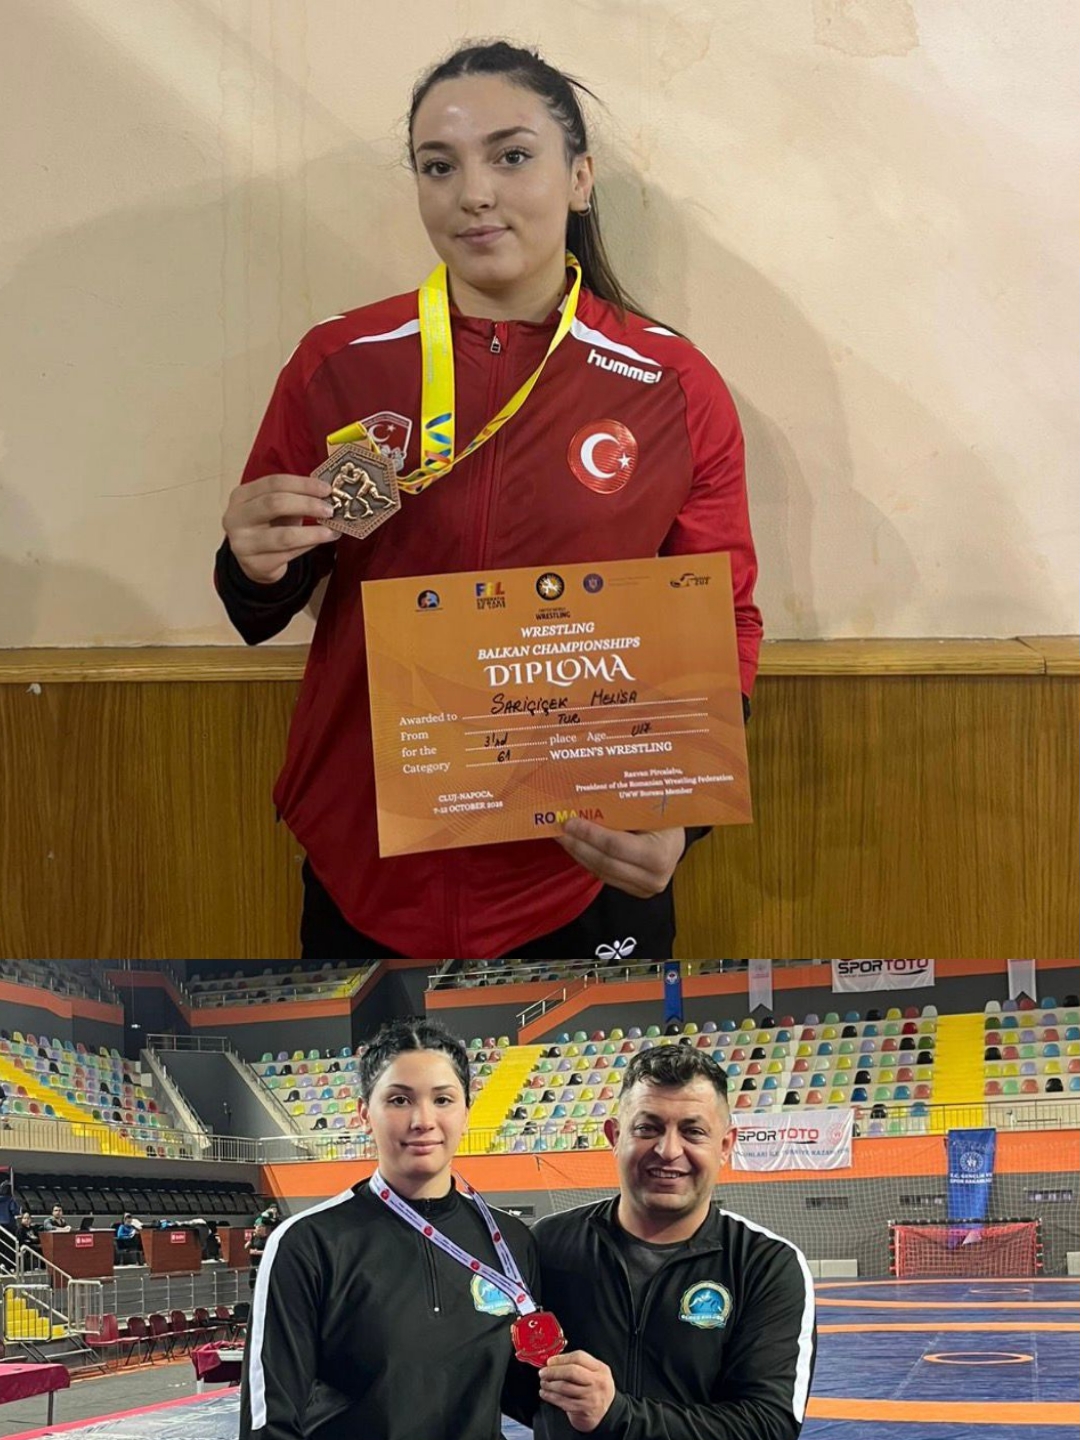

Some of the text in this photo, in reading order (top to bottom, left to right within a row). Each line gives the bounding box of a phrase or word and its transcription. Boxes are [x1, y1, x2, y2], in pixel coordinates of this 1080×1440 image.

[587, 348, 663, 384] hummel
[521, 621, 595, 639] WRESTLING
[477, 636, 642, 661] BALKAN CHAMPIONSHIPS
[483, 654, 637, 687] DIPLOMA
[400, 711, 458, 726] Awarded to
[400, 731, 430, 743] From
[549, 731, 607, 749] place Age
[401, 747, 438, 759] for the
[551, 741, 673, 761] WOMEN'S WRESTLING
[402, 762, 451, 775] Category
